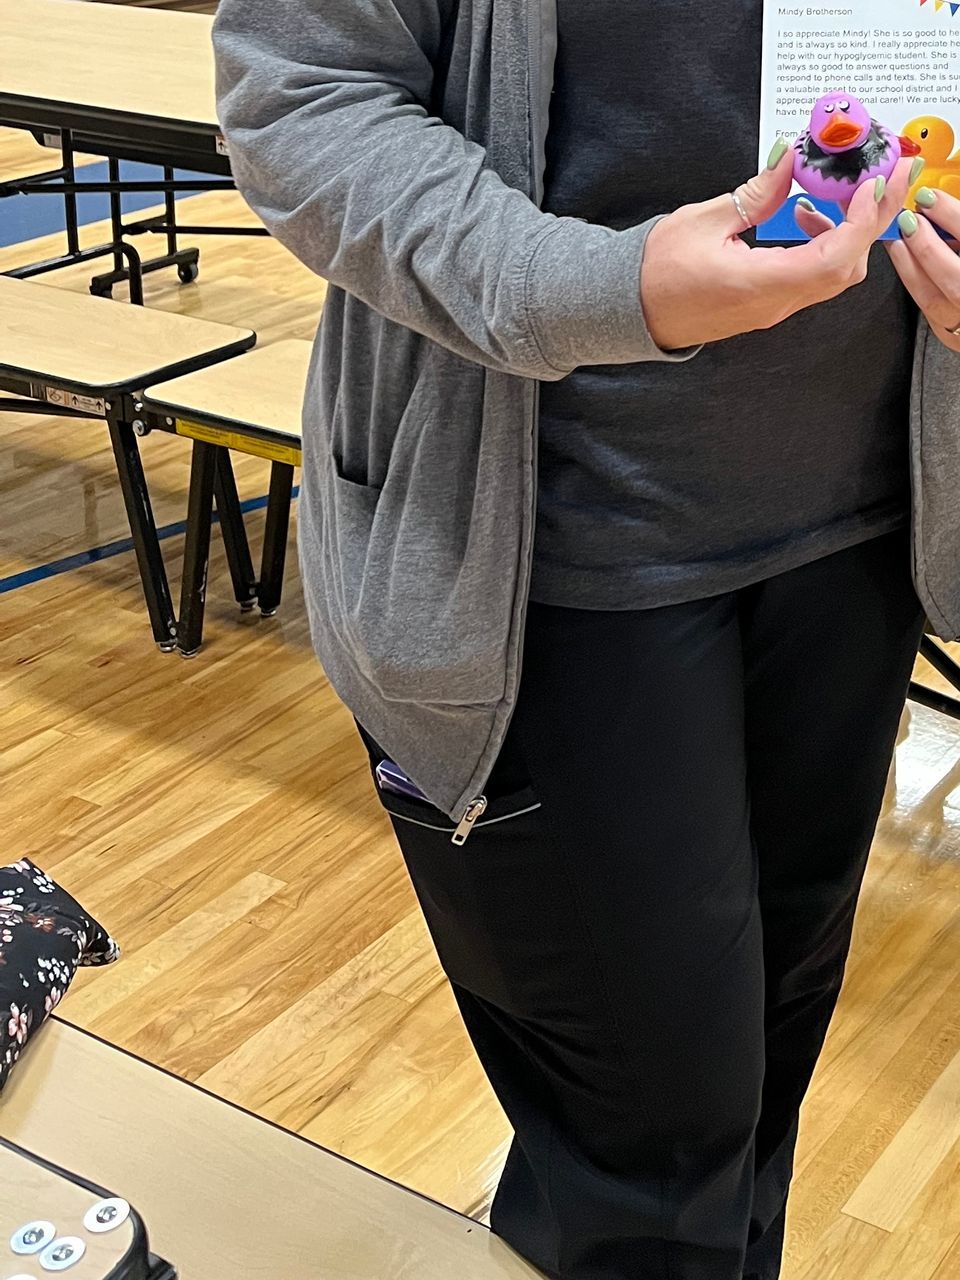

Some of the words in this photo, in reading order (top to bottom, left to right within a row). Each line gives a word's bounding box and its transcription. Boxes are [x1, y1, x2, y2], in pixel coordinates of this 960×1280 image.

[778, 7, 804, 17] Mindy
[806, 7, 853, 16] Brotherson
[795, 30, 841, 39] appreciate
[842, 29, 871, 39] Mindy!
[873, 29, 891, 38] She
[892, 29, 900, 37] is
[914, 29, 936, 38] good
[938, 29, 947, 37] to
[777, 41, 794, 49] and
[795, 41, 803, 49] is
[805, 41, 835, 50] always
[877, 40, 901, 49] really
[903, 40, 948, 49] appreciate
[777, 52, 796, 61] help
[797, 52, 815, 60] with
[833, 51, 892, 61] hypoglycemic
[894, 51, 928, 59] student.
[930, 51, 948, 59] She
[950, 51, 957, 59] is
[777, 63, 807, 73] always
[821, 63, 843, 73] good
[889, 62, 930, 71] questions
[932, 62, 949, 70] and
[776, 74, 812, 83] respond
[824, 73, 852, 83] phone
[853, 73, 873, 81] calls
[875, 73, 892, 81] and
[919, 72, 937, 81] She
[939, 72, 946, 80] is
[784, 85, 820, 93] valuable
[848, 85, 857, 93] to
[875, 84, 904, 93] school
[905, 84, 934, 92] district
[935, 84, 952, 92] and
[906, 95, 921, 103] We
[775, 108, 797, 116] have
[775, 129, 798, 138] From
